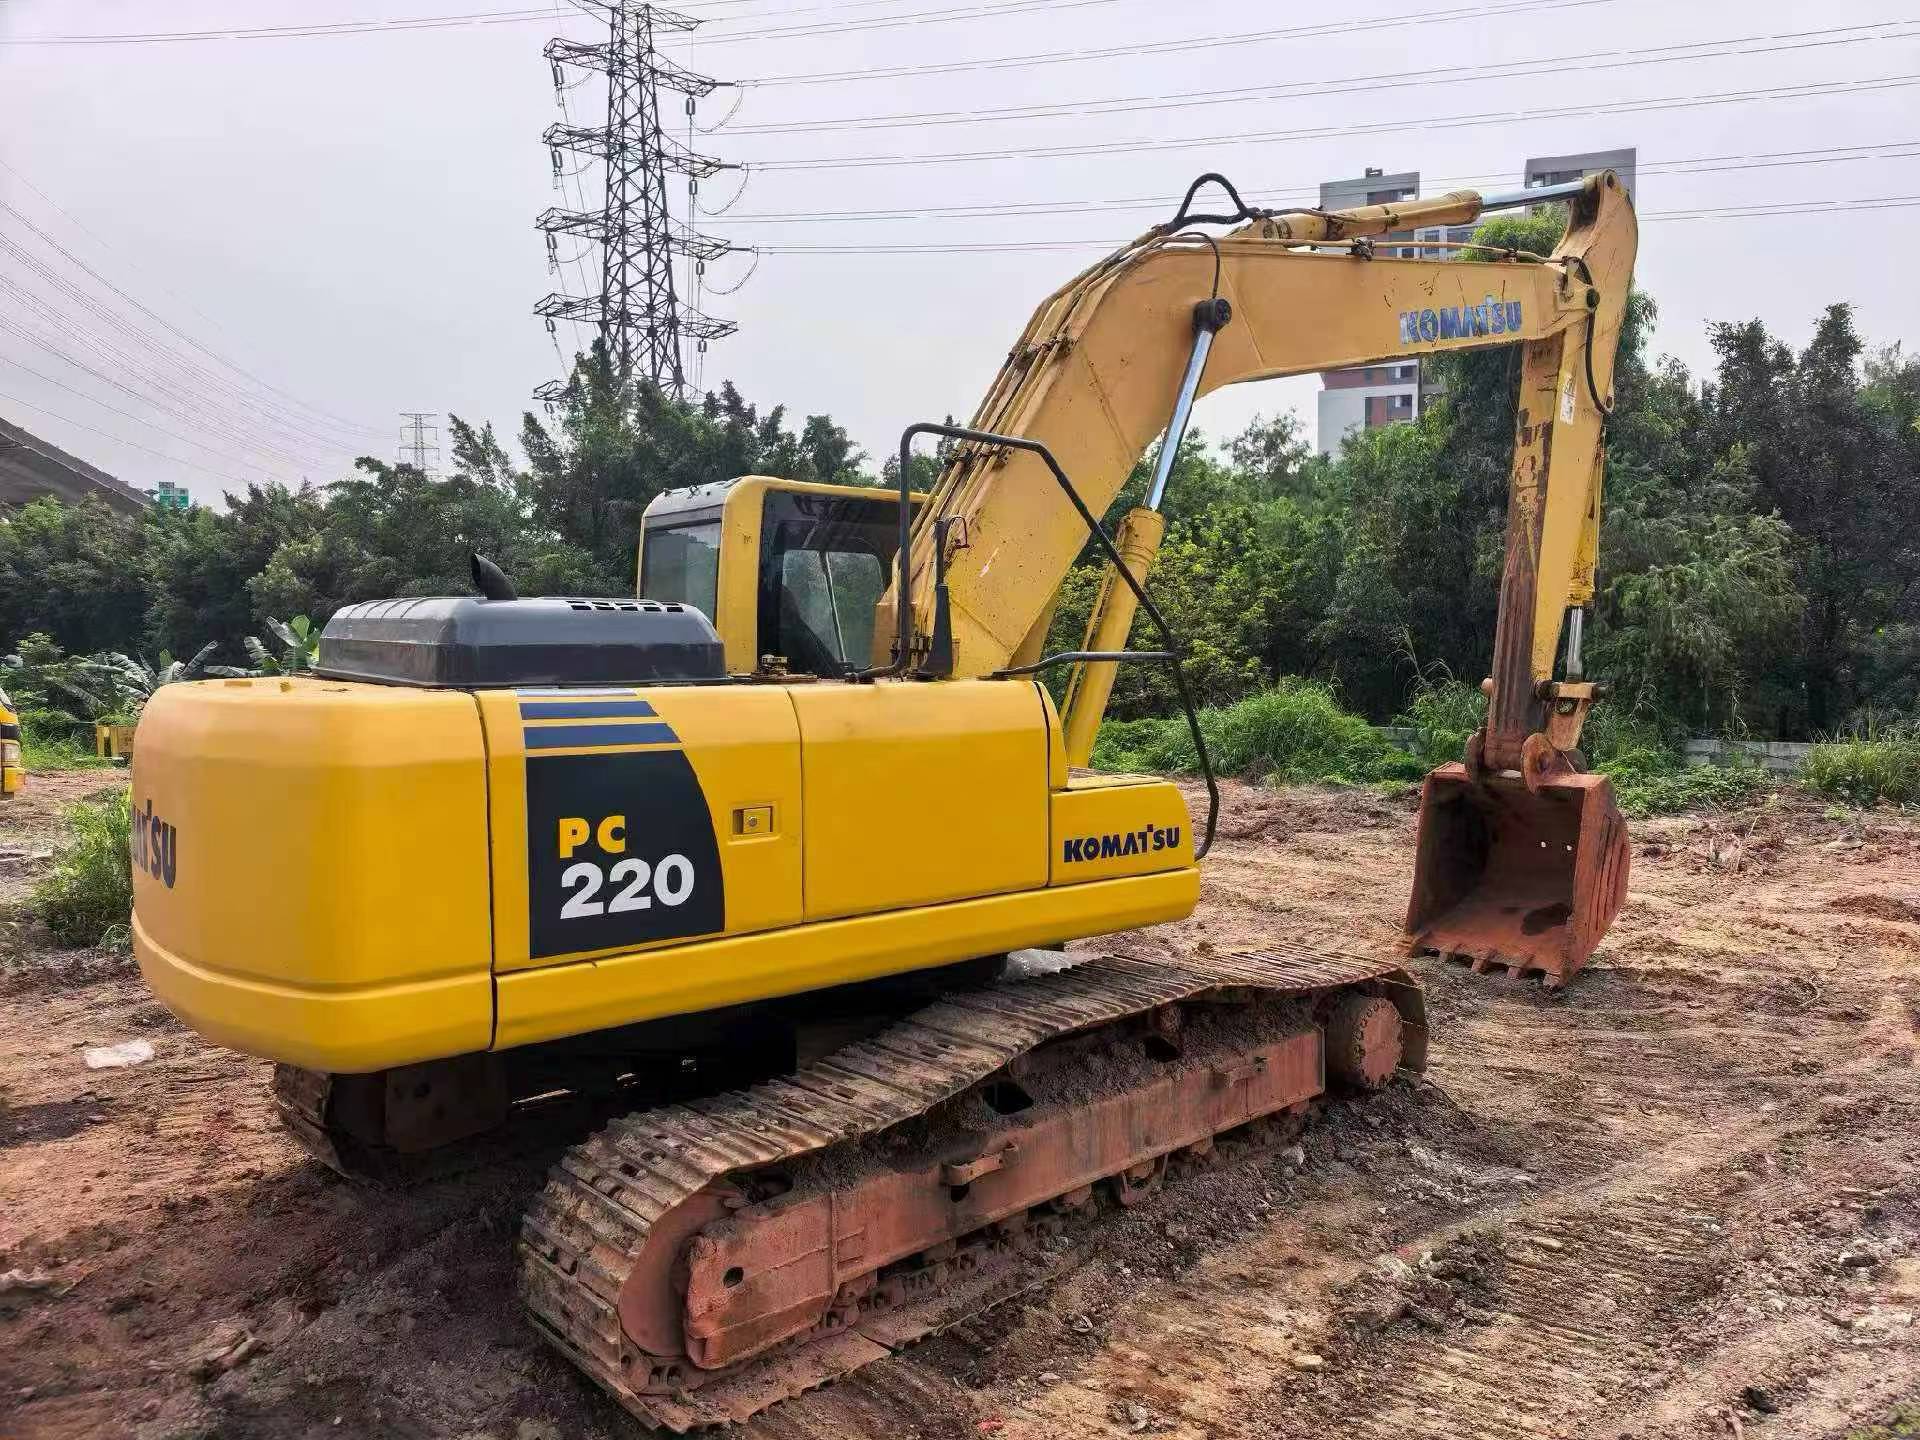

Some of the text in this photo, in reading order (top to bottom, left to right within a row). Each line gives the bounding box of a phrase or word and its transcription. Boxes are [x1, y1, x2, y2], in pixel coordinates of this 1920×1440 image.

[1400, 294, 1522, 344] KOMATSU
[559, 815, 626, 859] PC
[1063, 824, 1180, 863] KOMATSU
[560, 853, 695, 919] 220
